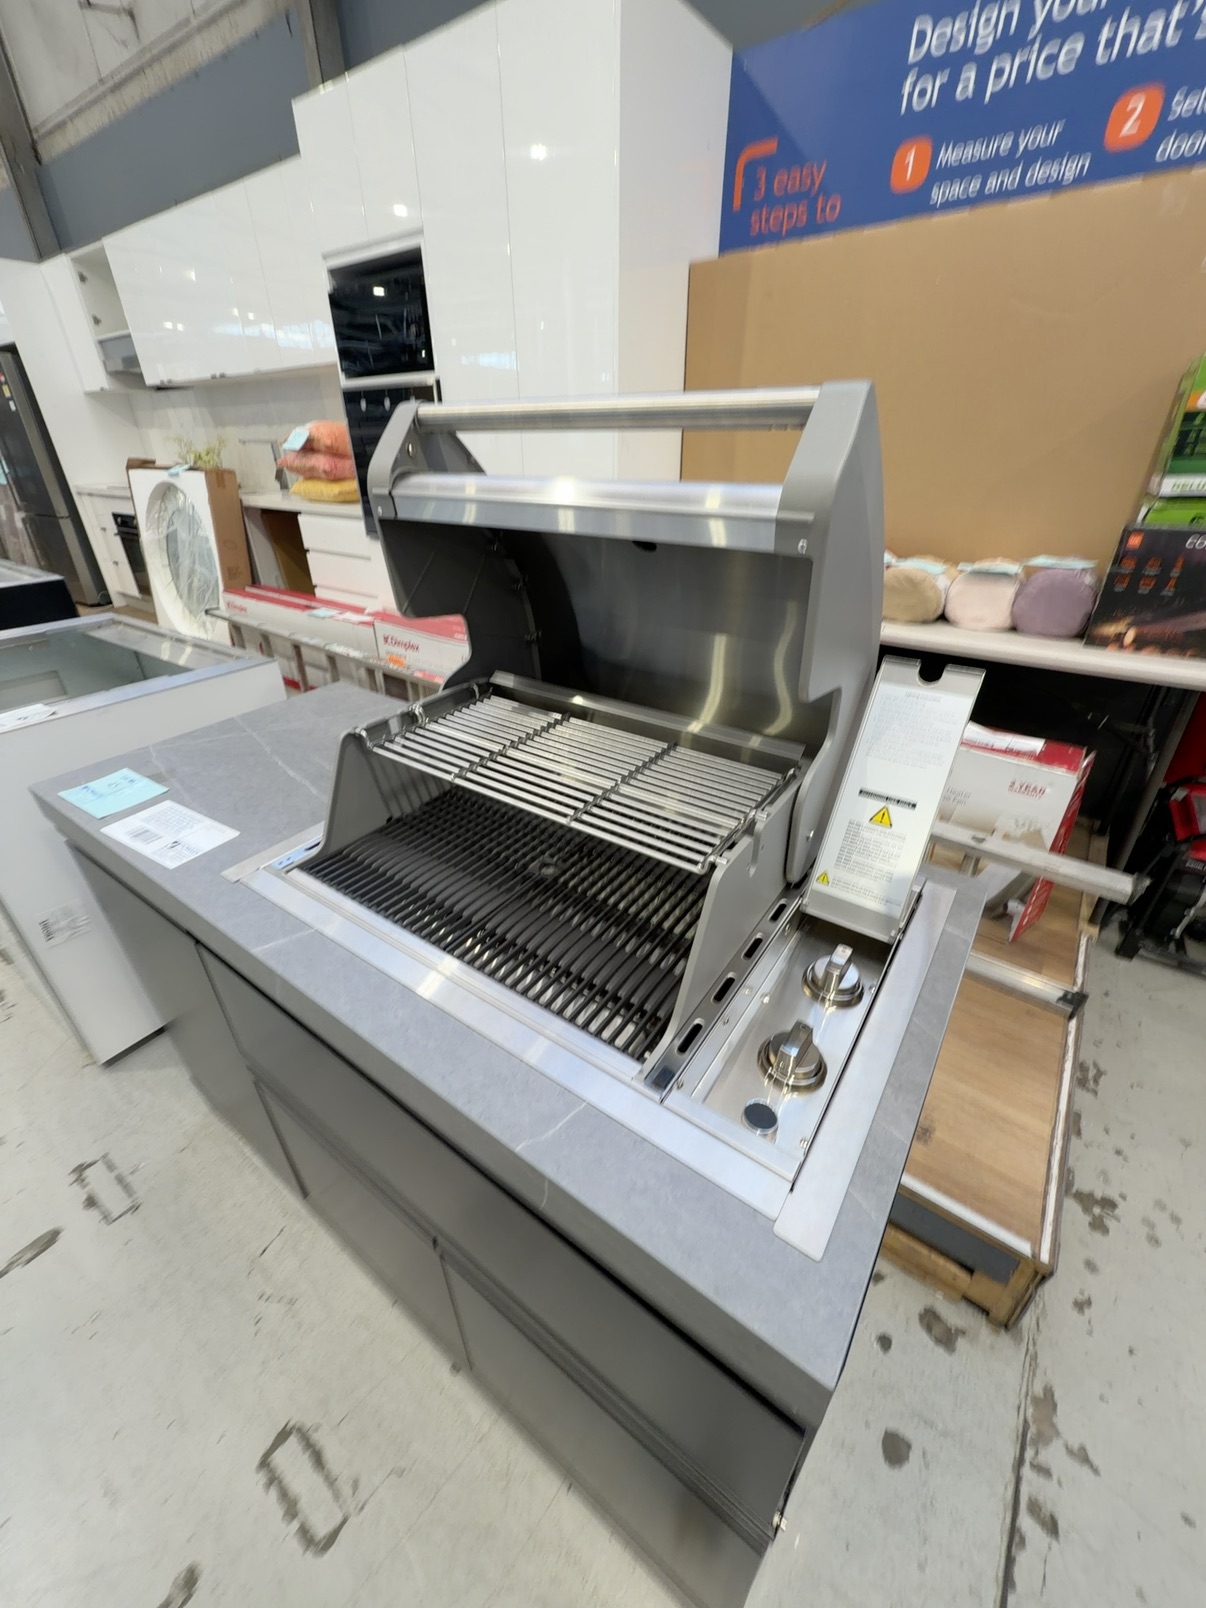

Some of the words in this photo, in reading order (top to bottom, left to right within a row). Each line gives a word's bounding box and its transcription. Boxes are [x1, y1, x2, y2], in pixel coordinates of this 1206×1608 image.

[908, 0, 1020, 65] Design
[900, 66, 951, 115] for
[955, 61, 977, 102] a
[984, 31, 1085, 105] price
[1119, 91, 1146, 137] 2
[904, 145, 917, 181] 1
[936, 130, 1014, 170] Measure
[1015, 118, 1067, 159] your
[754, 165, 766, 202] 3
[774, 158, 827, 197] easy
[930, 173, 983, 208] space
[985, 160, 1023, 195] and
[1025, 151, 1092, 186] design
[750, 199, 808, 237] steps
[816, 192, 841, 224] to
